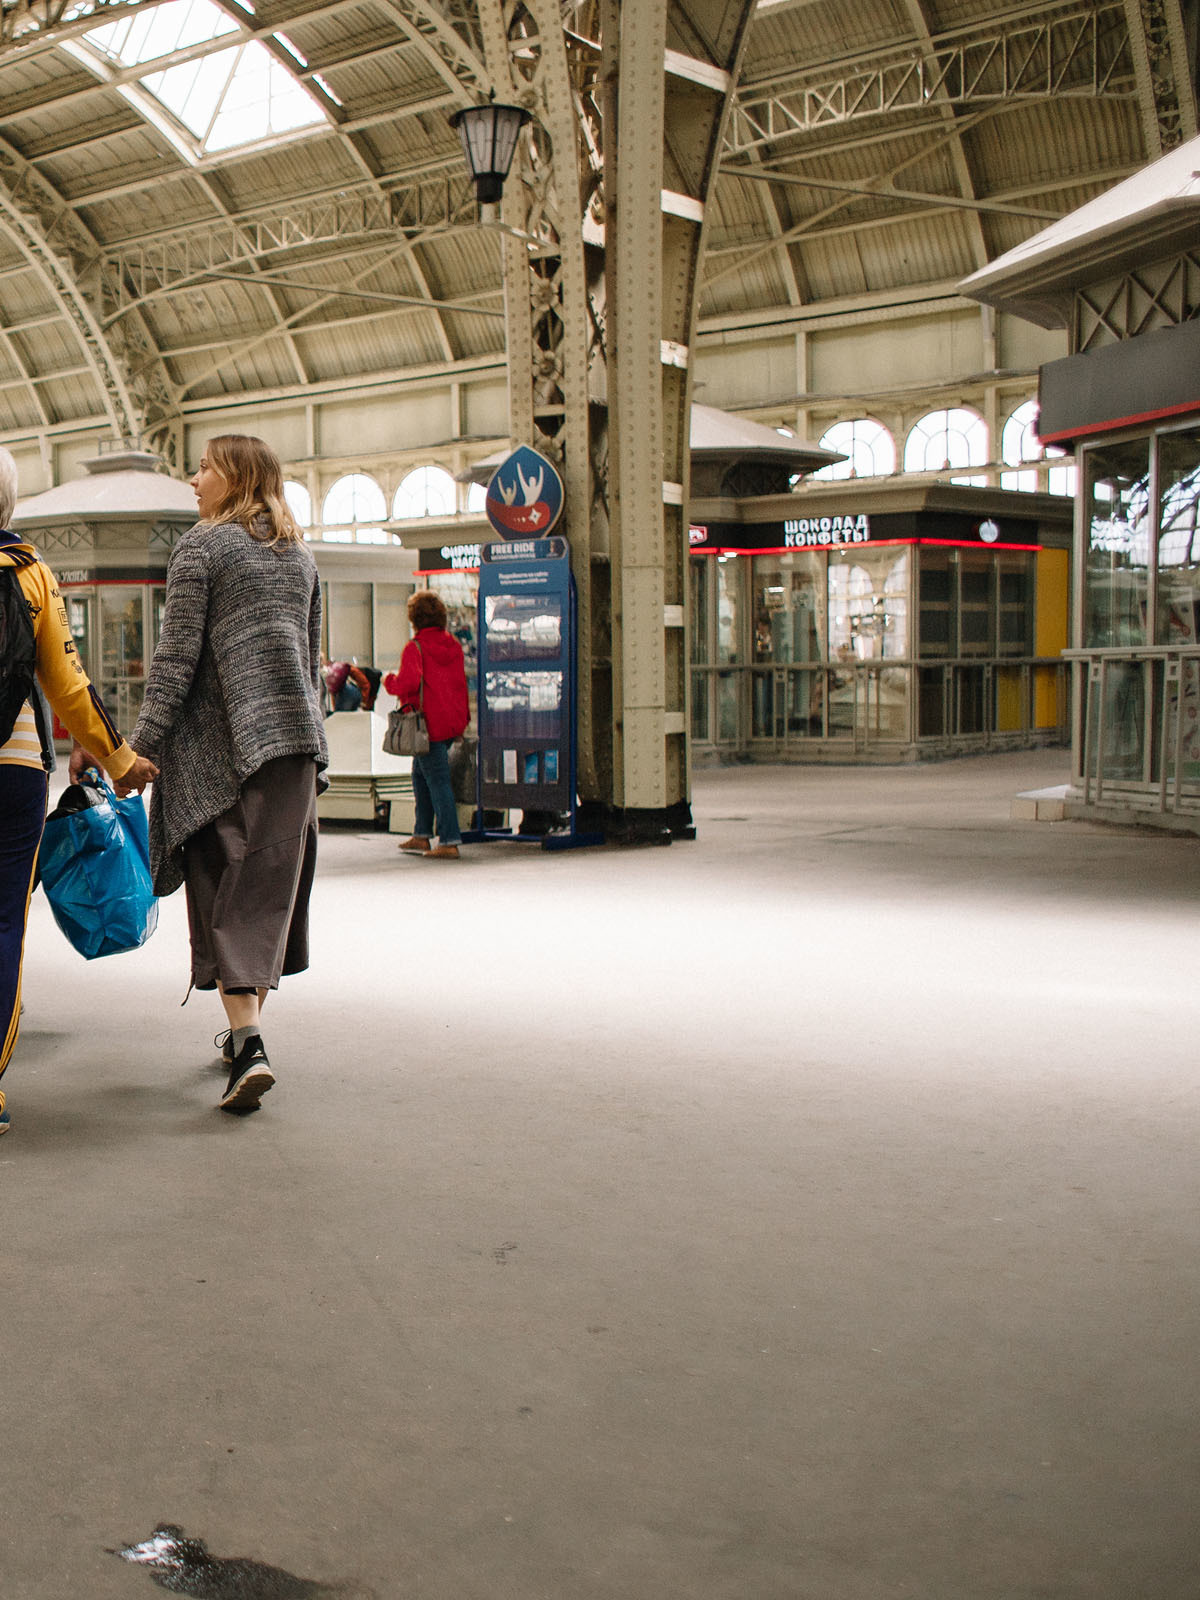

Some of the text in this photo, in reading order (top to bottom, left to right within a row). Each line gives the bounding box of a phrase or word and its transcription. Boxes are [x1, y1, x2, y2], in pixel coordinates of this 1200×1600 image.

[784, 514, 869, 534] ШОКОЛАД
[784, 528, 870, 547] КОНФЕТЫ
[491, 541, 536, 555] FREE RIDE
